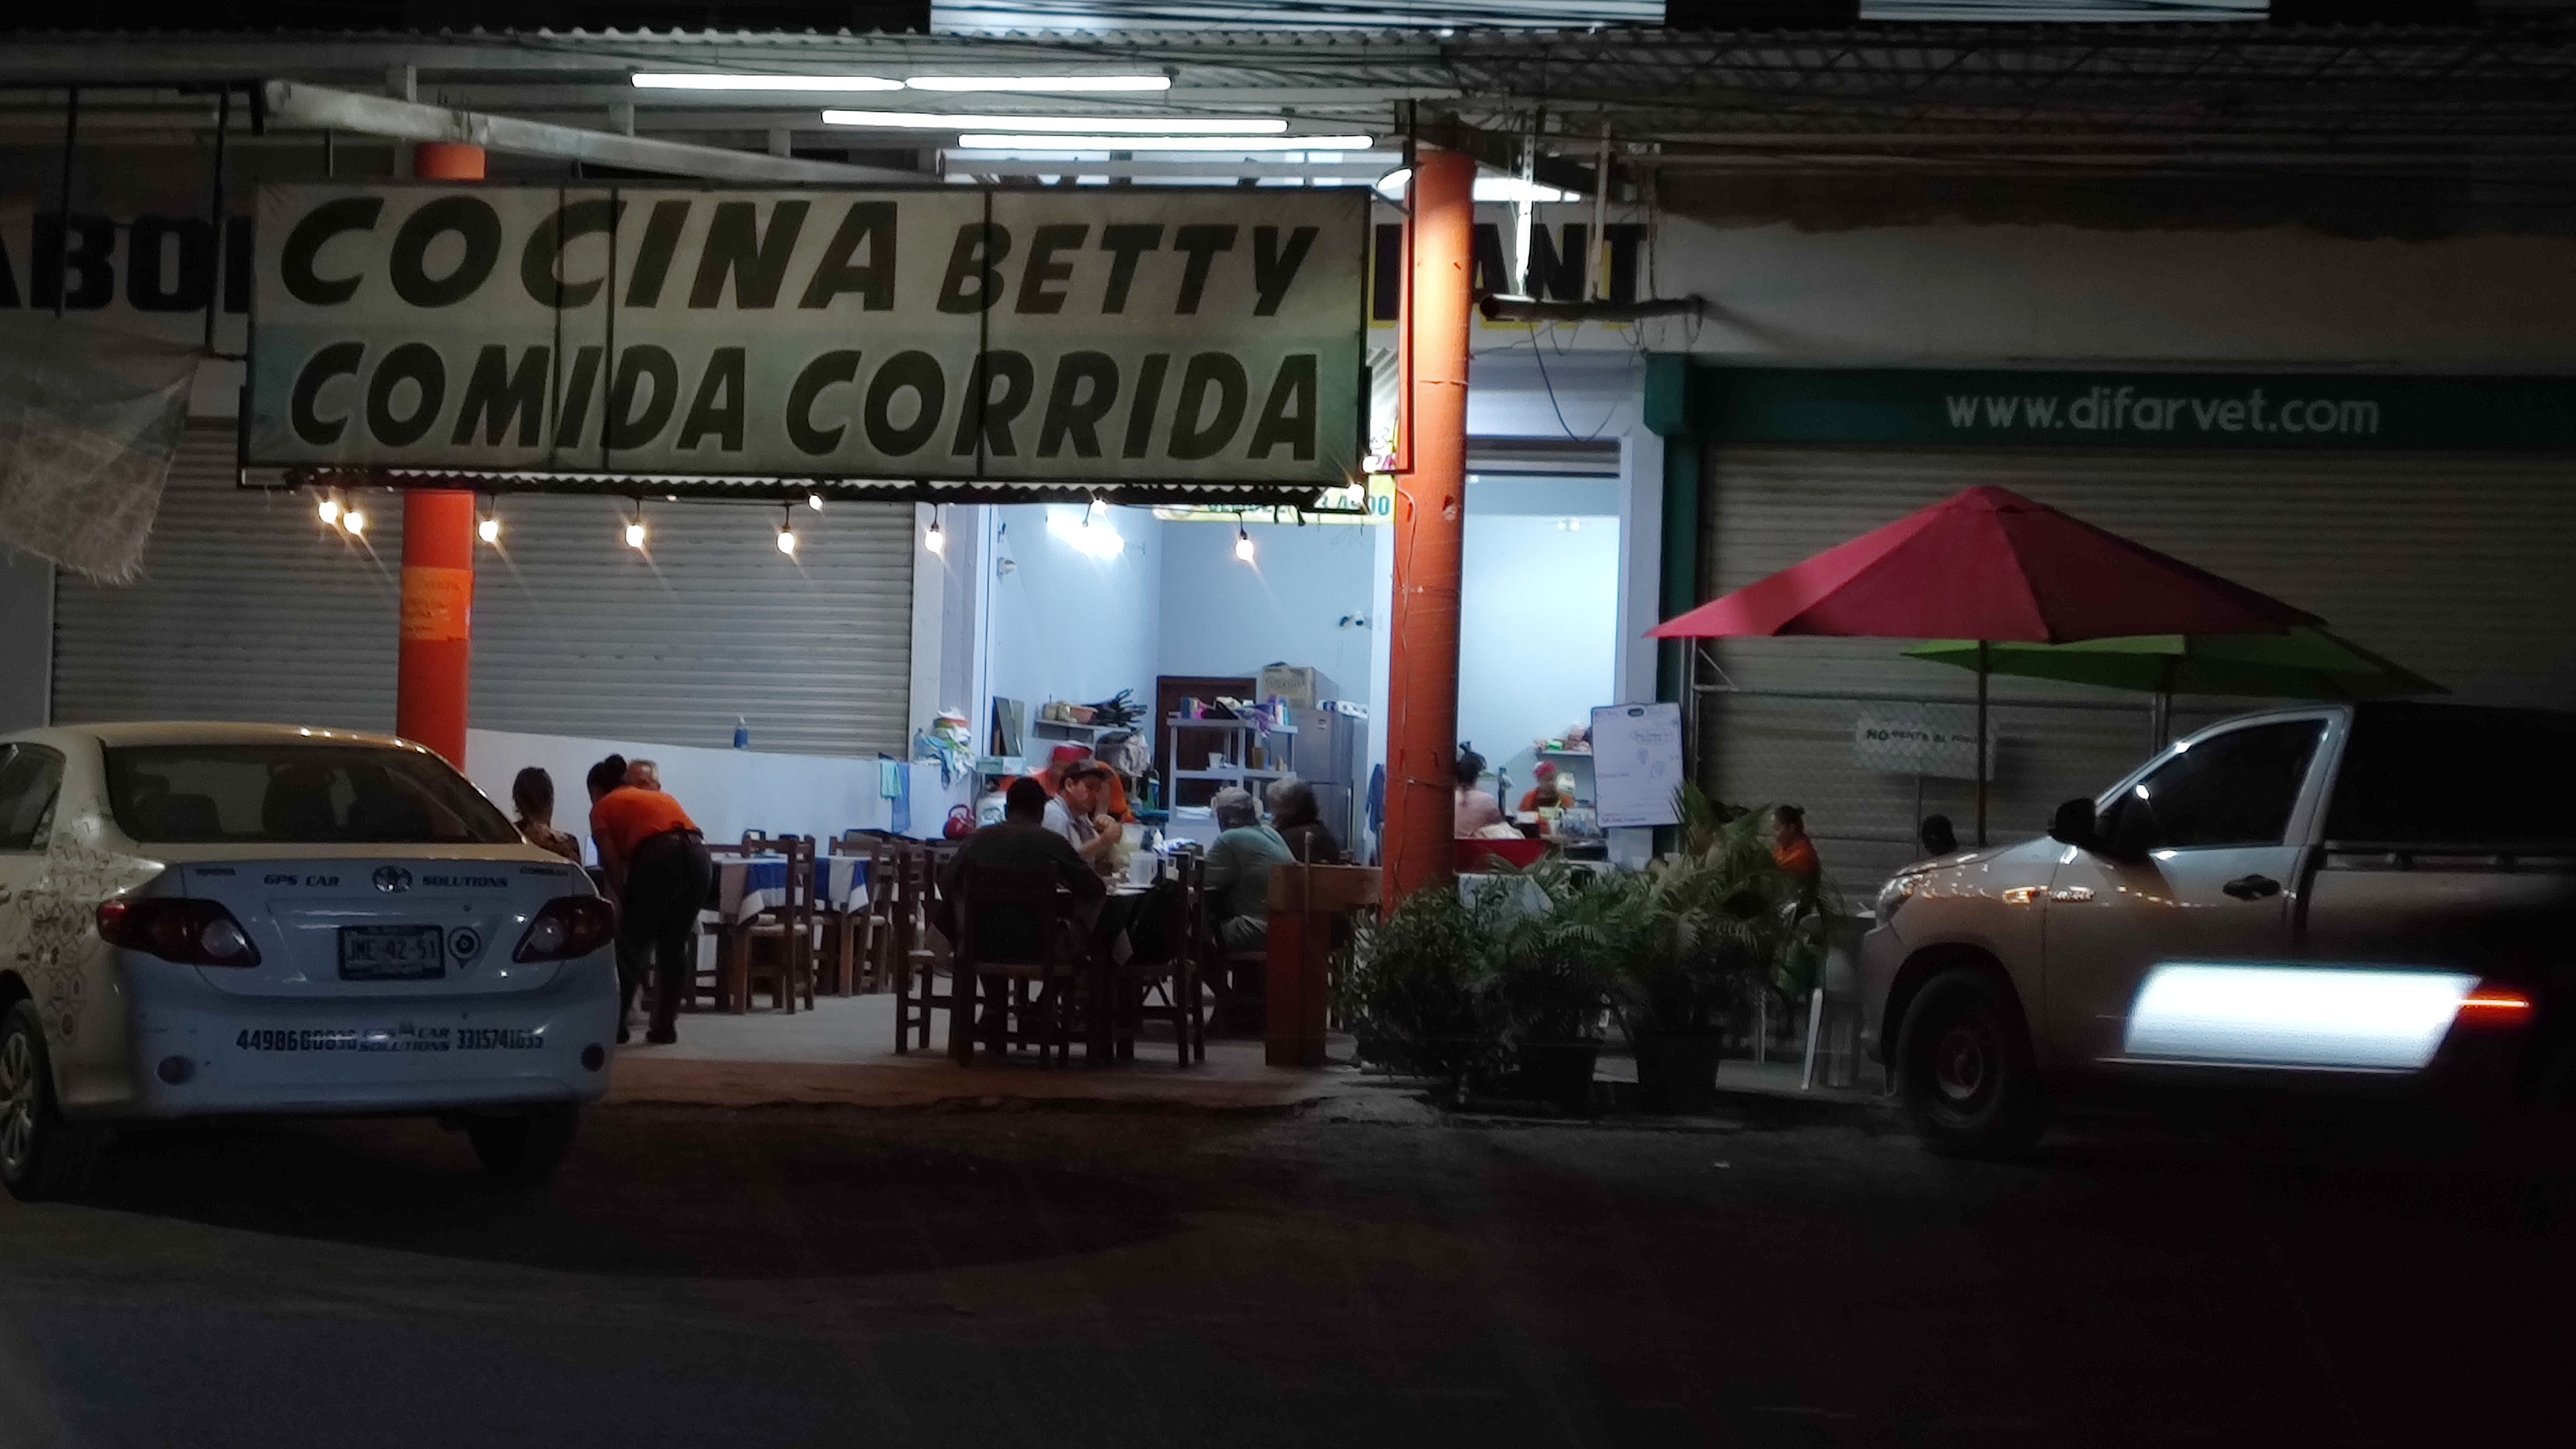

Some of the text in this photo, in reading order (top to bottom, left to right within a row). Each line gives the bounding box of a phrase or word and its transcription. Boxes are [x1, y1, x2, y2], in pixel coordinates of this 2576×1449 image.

[281, 195, 1320, 316] COCINA BETTY
[291, 342, 1317, 460] COMIDA CORRIDA
[1866, 729, 1889, 741] NO
[264, 874, 509, 888] GPS CAR SOLUTIONS
